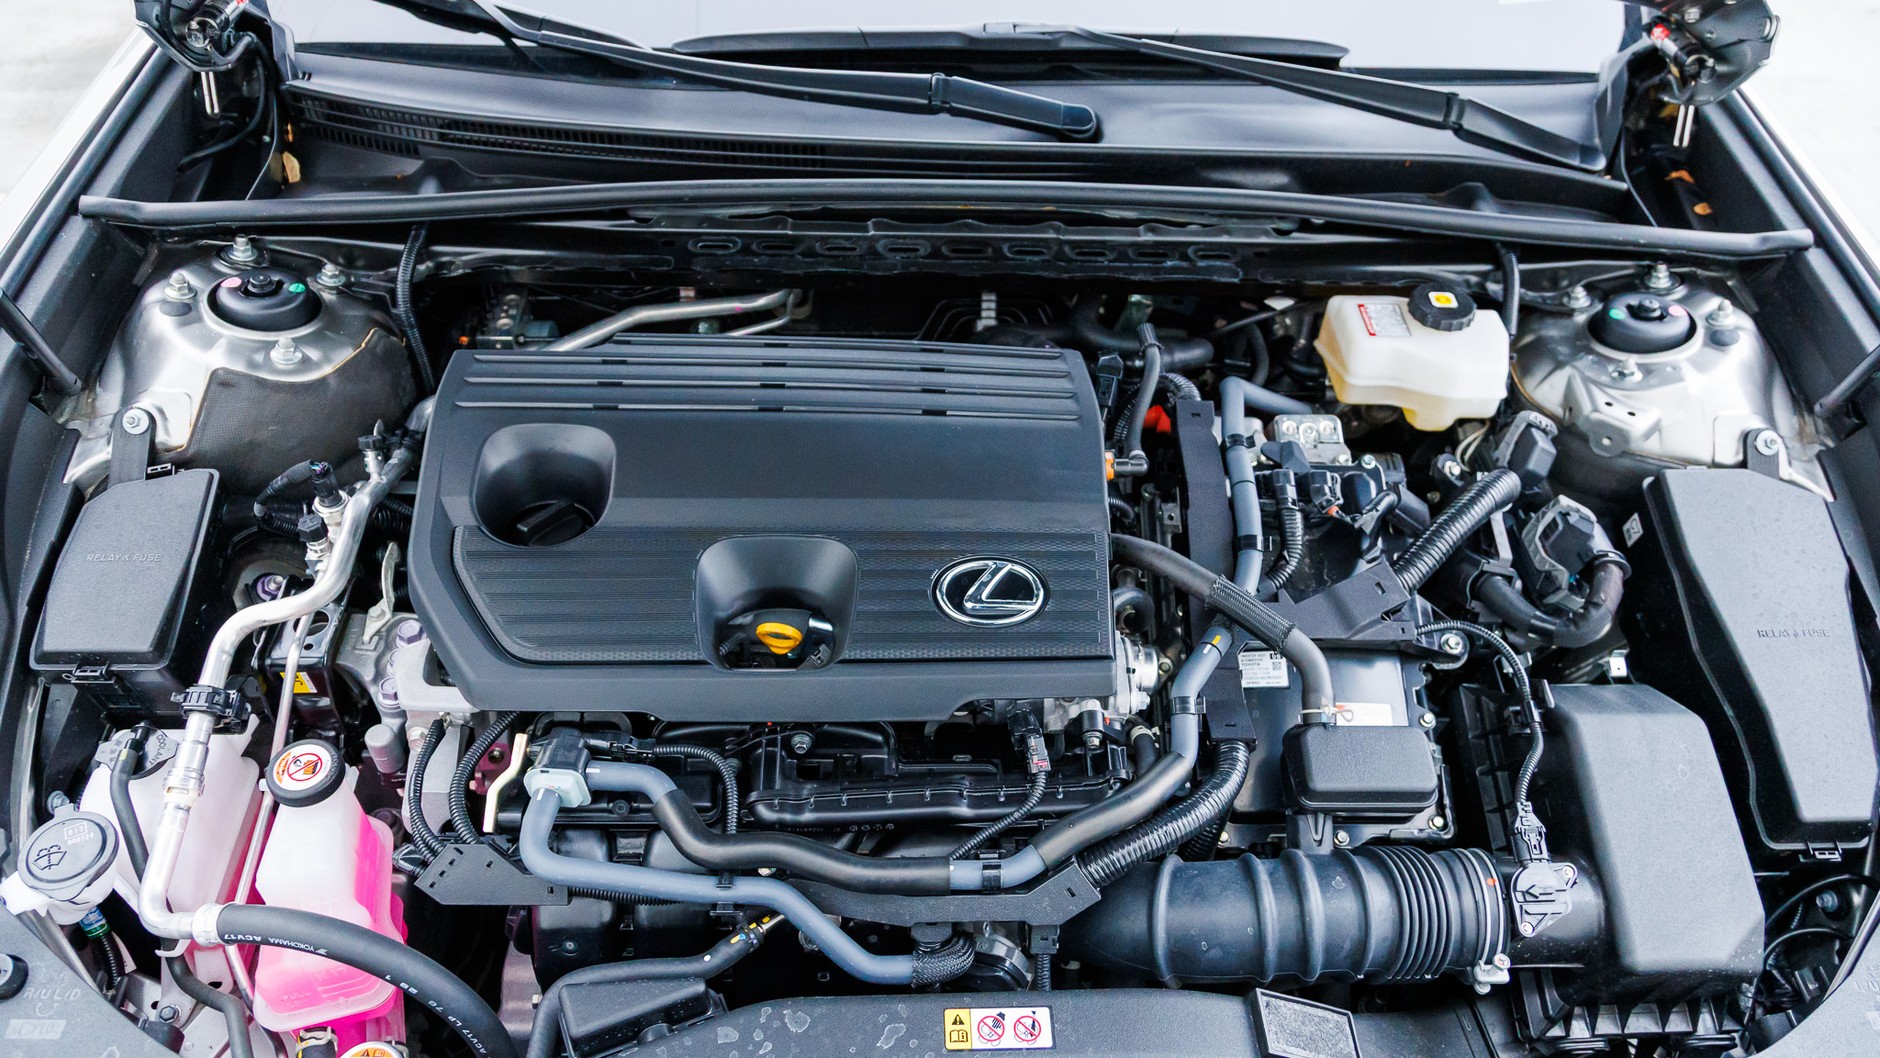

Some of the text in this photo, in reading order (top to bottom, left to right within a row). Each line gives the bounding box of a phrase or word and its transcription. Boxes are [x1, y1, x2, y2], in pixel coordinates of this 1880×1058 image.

[86, 553, 122, 562] RELAY
[132, 553, 162, 562] FUSE
[1757, 629, 1790, 638] RELAY
[1802, 629, 1831, 638] FUSE
[224, 933, 315, 952] YOKOHAMA ACV17
